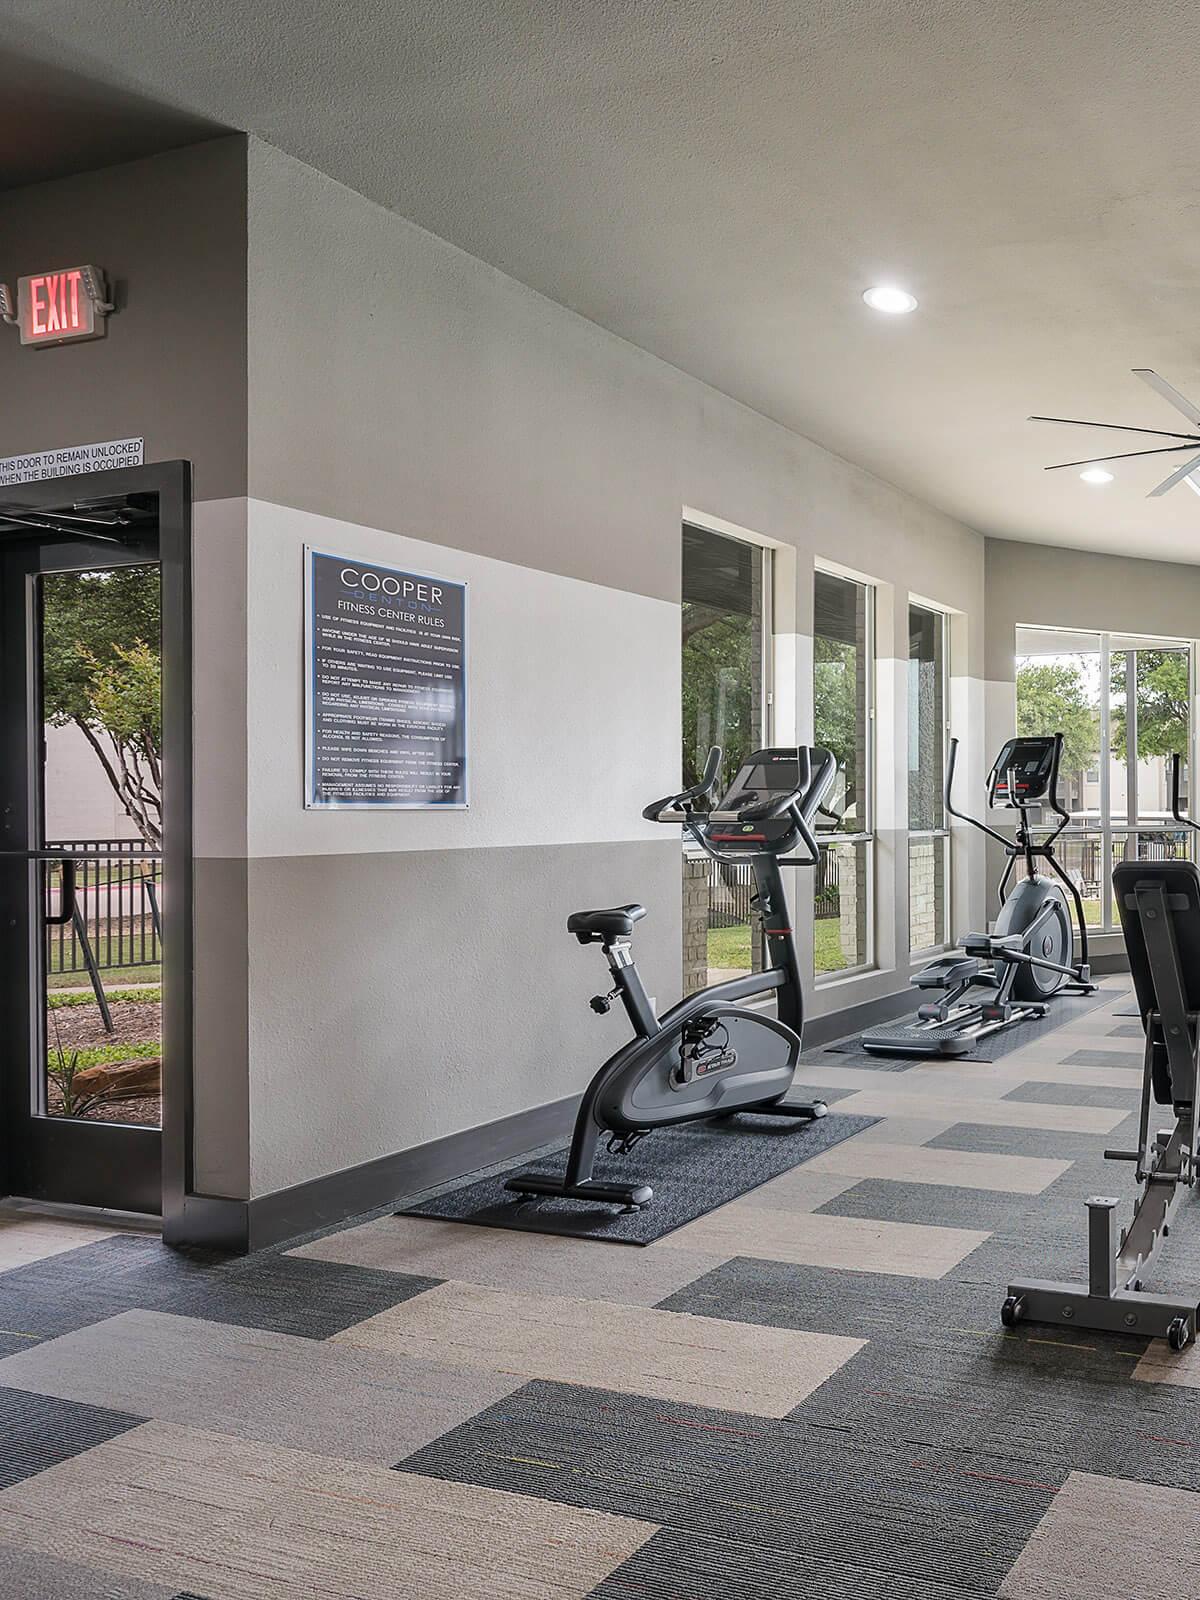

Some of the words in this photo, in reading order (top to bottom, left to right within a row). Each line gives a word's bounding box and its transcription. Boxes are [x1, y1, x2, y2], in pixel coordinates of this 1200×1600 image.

[31, 271, 81, 335] EXIT
[18, 457, 41, 469] DOOR
[43, 456, 54, 465] TO
[56, 448, 89, 463] REMAIN
[92, 442, 140, 458] UNLOCKED
[24, 470, 38, 480] THE
[42, 463, 80, 478] BUILDING
[82, 462, 92, 472] IS
[93, 455, 140, 470] OCCUPIED
[340, 568, 442, 605] COOPER
[338, 600, 375, 616] FITNESS
[378, 607, 416, 622] CENTER
[418, 614, 445, 628] RULES
[354, 590, 432, 612] DENTON
